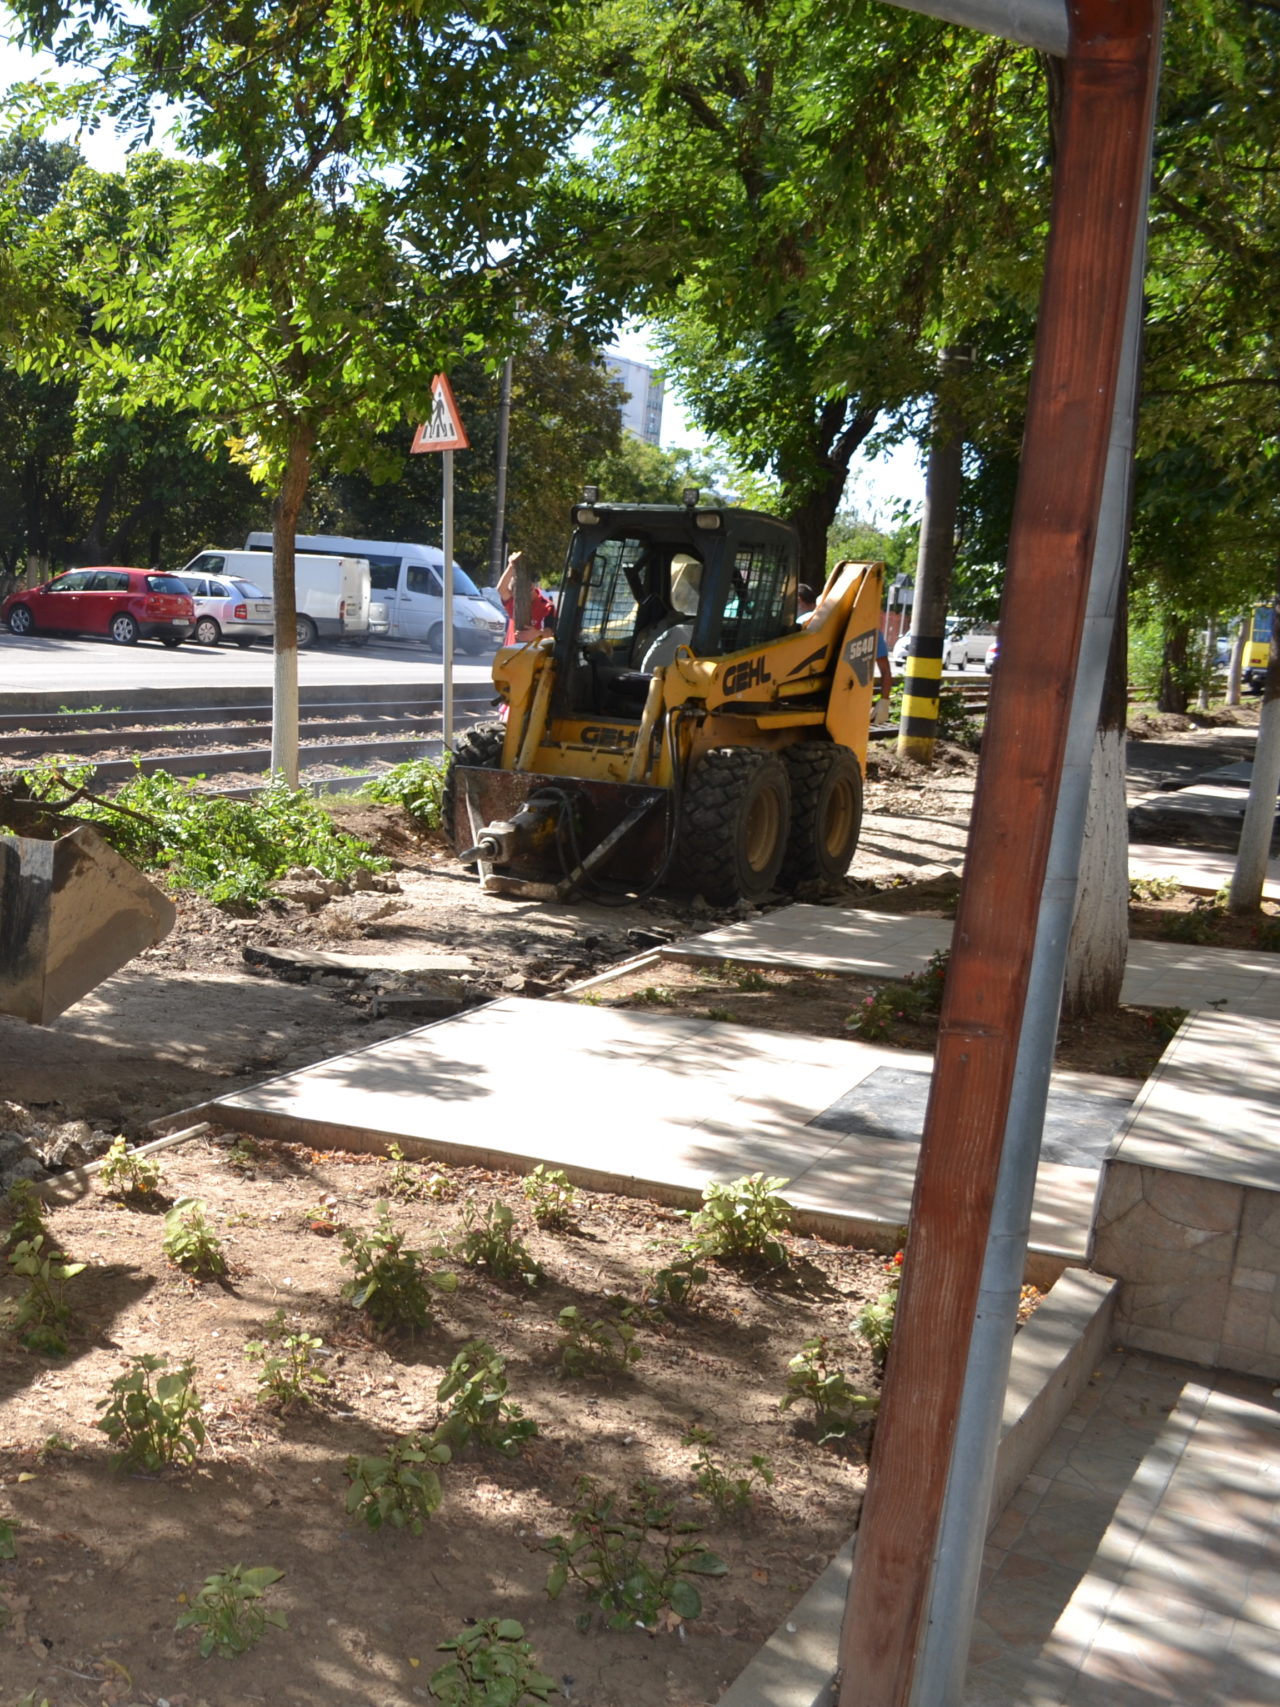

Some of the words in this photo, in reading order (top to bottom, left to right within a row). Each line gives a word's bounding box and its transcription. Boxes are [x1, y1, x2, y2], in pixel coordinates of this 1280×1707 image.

[850, 636, 874, 660] 5640
[723, 655, 771, 696] GEHL
[581, 726, 651, 748] GEH
